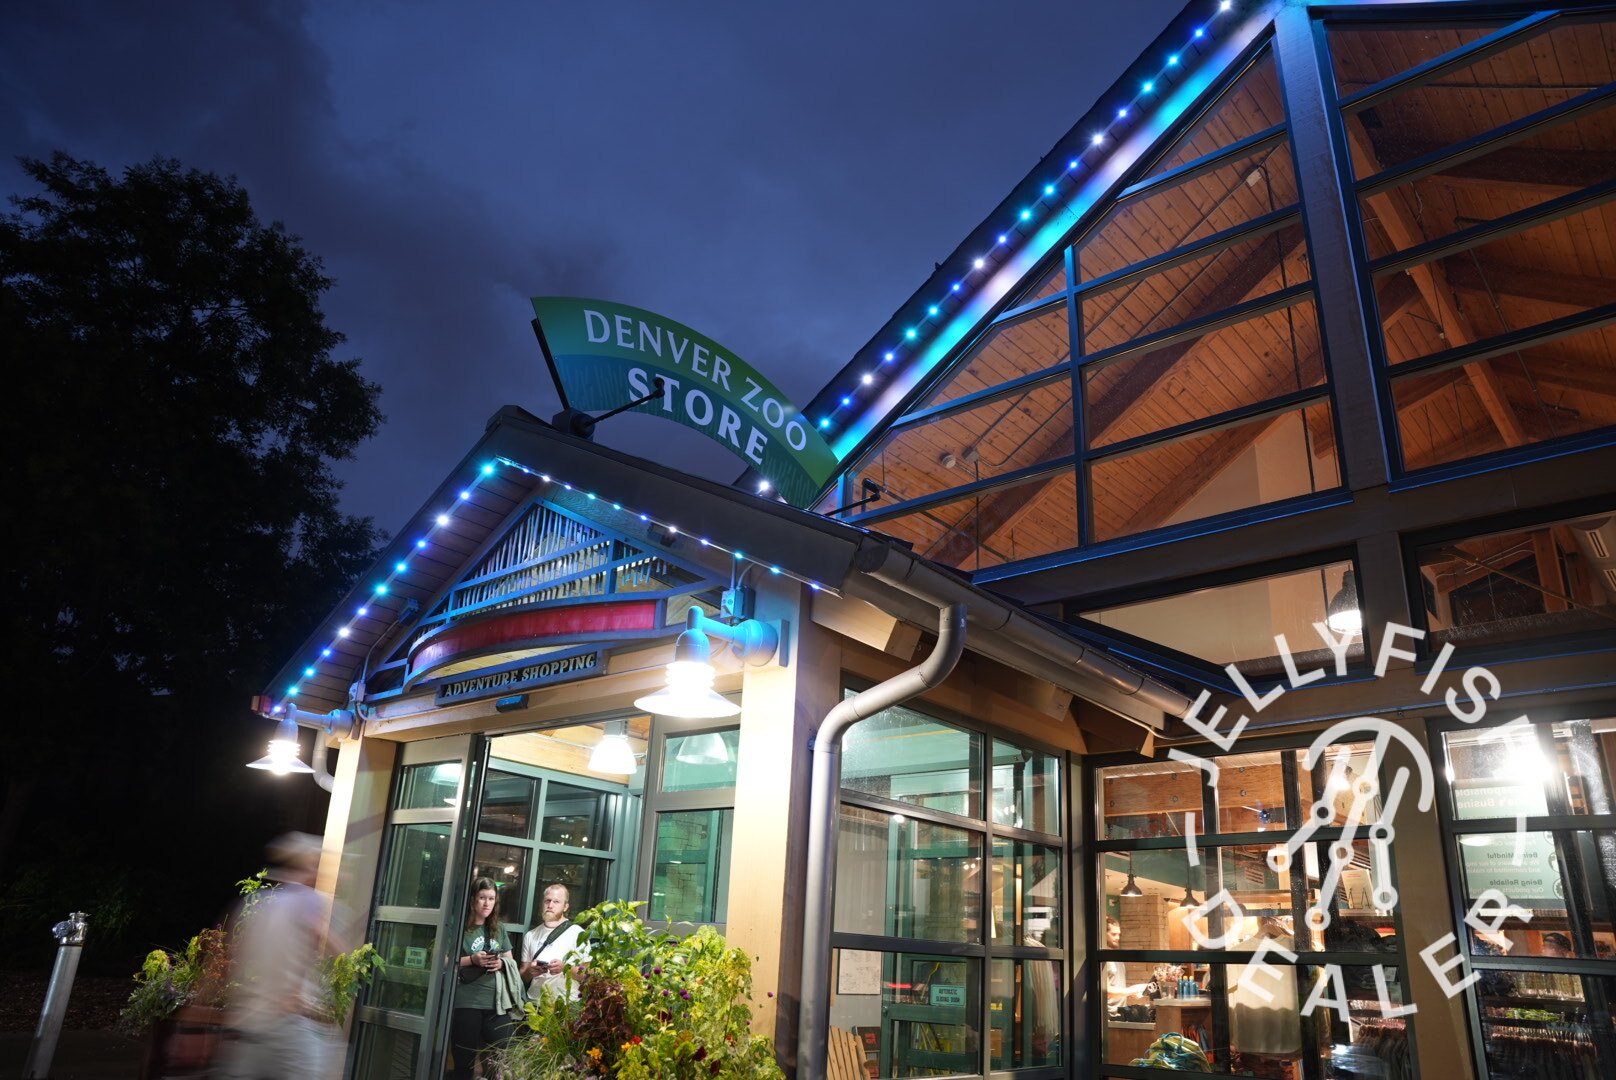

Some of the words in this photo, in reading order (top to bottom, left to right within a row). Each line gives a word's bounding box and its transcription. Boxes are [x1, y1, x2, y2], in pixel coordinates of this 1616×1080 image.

[584, 309, 731, 391] DENVER
[741, 377, 807, 451] ZOO
[628, 367, 768, 465] STORE
[445, 670, 519, 697] ADVENTURE
[521, 653, 595, 682] SHOPPING
